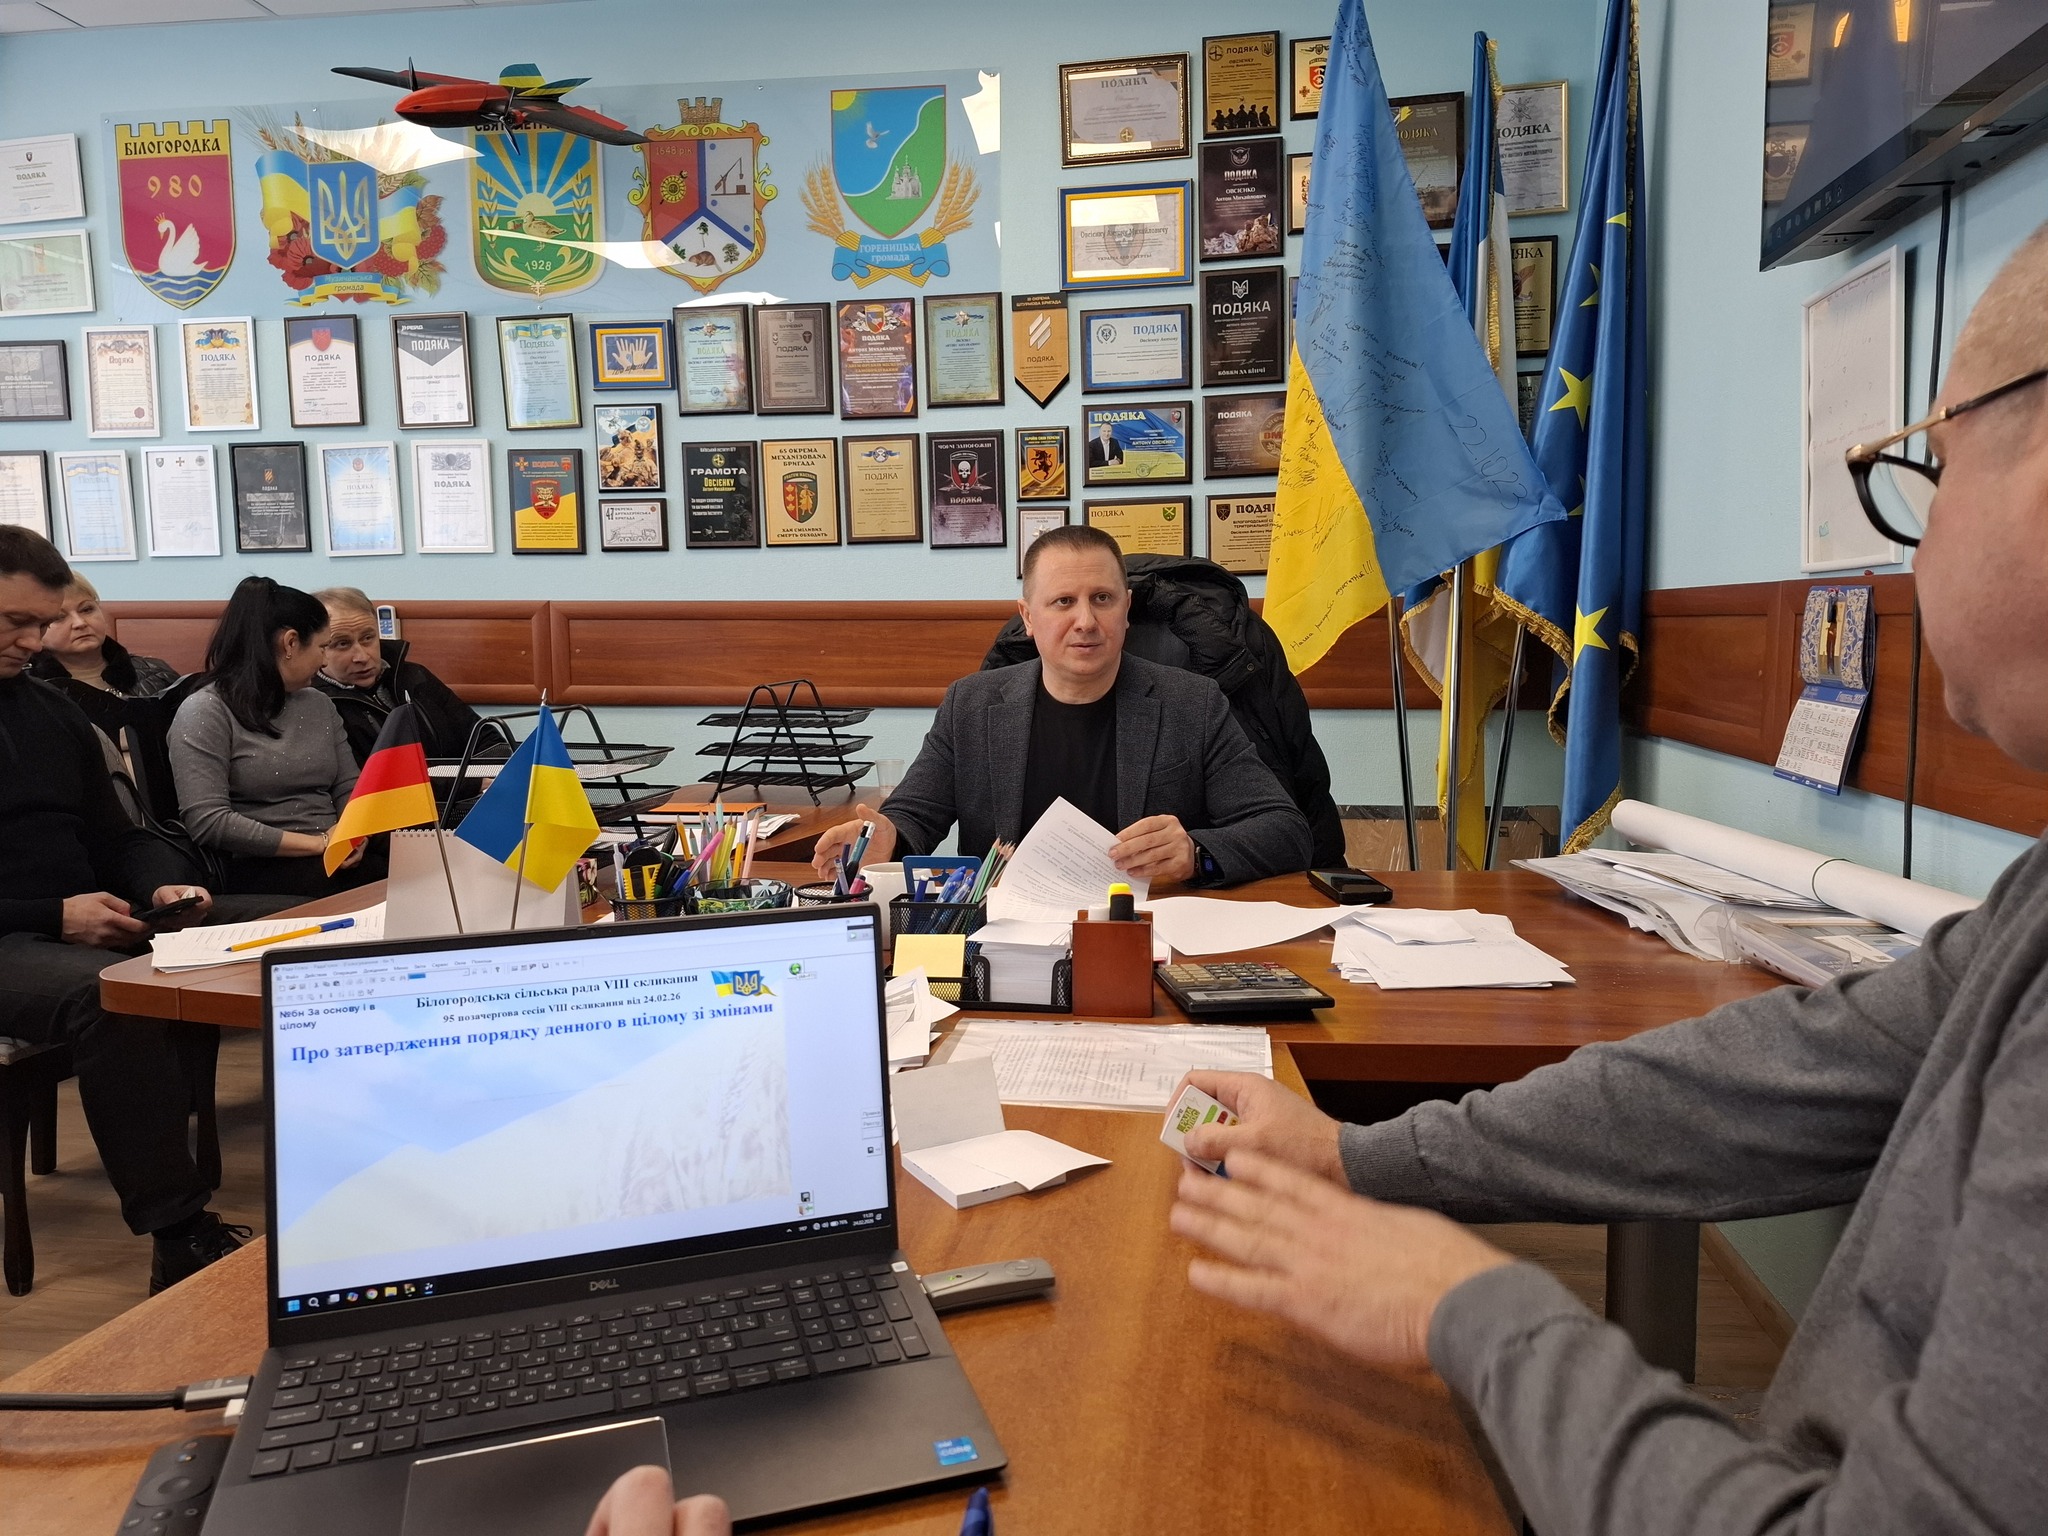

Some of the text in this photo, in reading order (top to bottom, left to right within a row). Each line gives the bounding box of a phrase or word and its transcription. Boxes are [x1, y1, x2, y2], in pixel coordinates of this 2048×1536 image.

[1226, 46, 1259, 54] ПОДЯКА
[1100, 77, 1148, 89] ПОДЯКА
[124, 138, 221, 156] БІЛОГОРОДКА
[1224, 169, 1258, 181] ПОДЯКА
[147, 174, 202, 199] 980
[859, 242, 922, 254] ГОРЕНИЦЬКА
[871, 253, 910, 264] громада
[524, 260, 552, 272] 1928
[334, 284, 365, 292] громада
[1212, 301, 1271, 316] ПОДЯКА
[1133, 324, 1178, 336] ПОДЯКА
[862, 334, 891, 342] ПОДЯКА
[412, 338, 450, 352] ПОДЯКА
[519, 340, 556, 350] Подяка
[109, 356, 134, 366] Подяка
[200, 352, 236, 364] ПОДЯКА
[304, 354, 341, 363] ПОДЯКА
[1094, 411, 1147, 422] ПОДЯКА
[1217, 410, 1253, 420] ПОДЯКА
[690, 468, 748, 476] ГРАМОТА
[864, 472, 899, 480] ПОДЯКА
[434, 480, 472, 488] ПОДЯКА
[960, 482, 970, 490] 72
[950, 496, 982, 504] ПОДЯКА
[606, 507, 615, 520] 47
[1090, 510, 1125, 518] ПОДЯКА
[1236, 504, 1276, 514] ПОДЯ
[416, 973, 699, 1009] Білогородська сільська рада VIII скликання
[307, 1008, 320, 1018] За
[323, 1005, 360, 1016] основу
[443, 992, 682, 1024] 95 позачергова сесія VIII скликання від 24.02.26
[279, 1020, 317, 1031] цілому
[291, 1002, 774, 1064] Про затвердження порядку денного в цілому зі змінами
[590, 1278, 620, 1291] DELL
